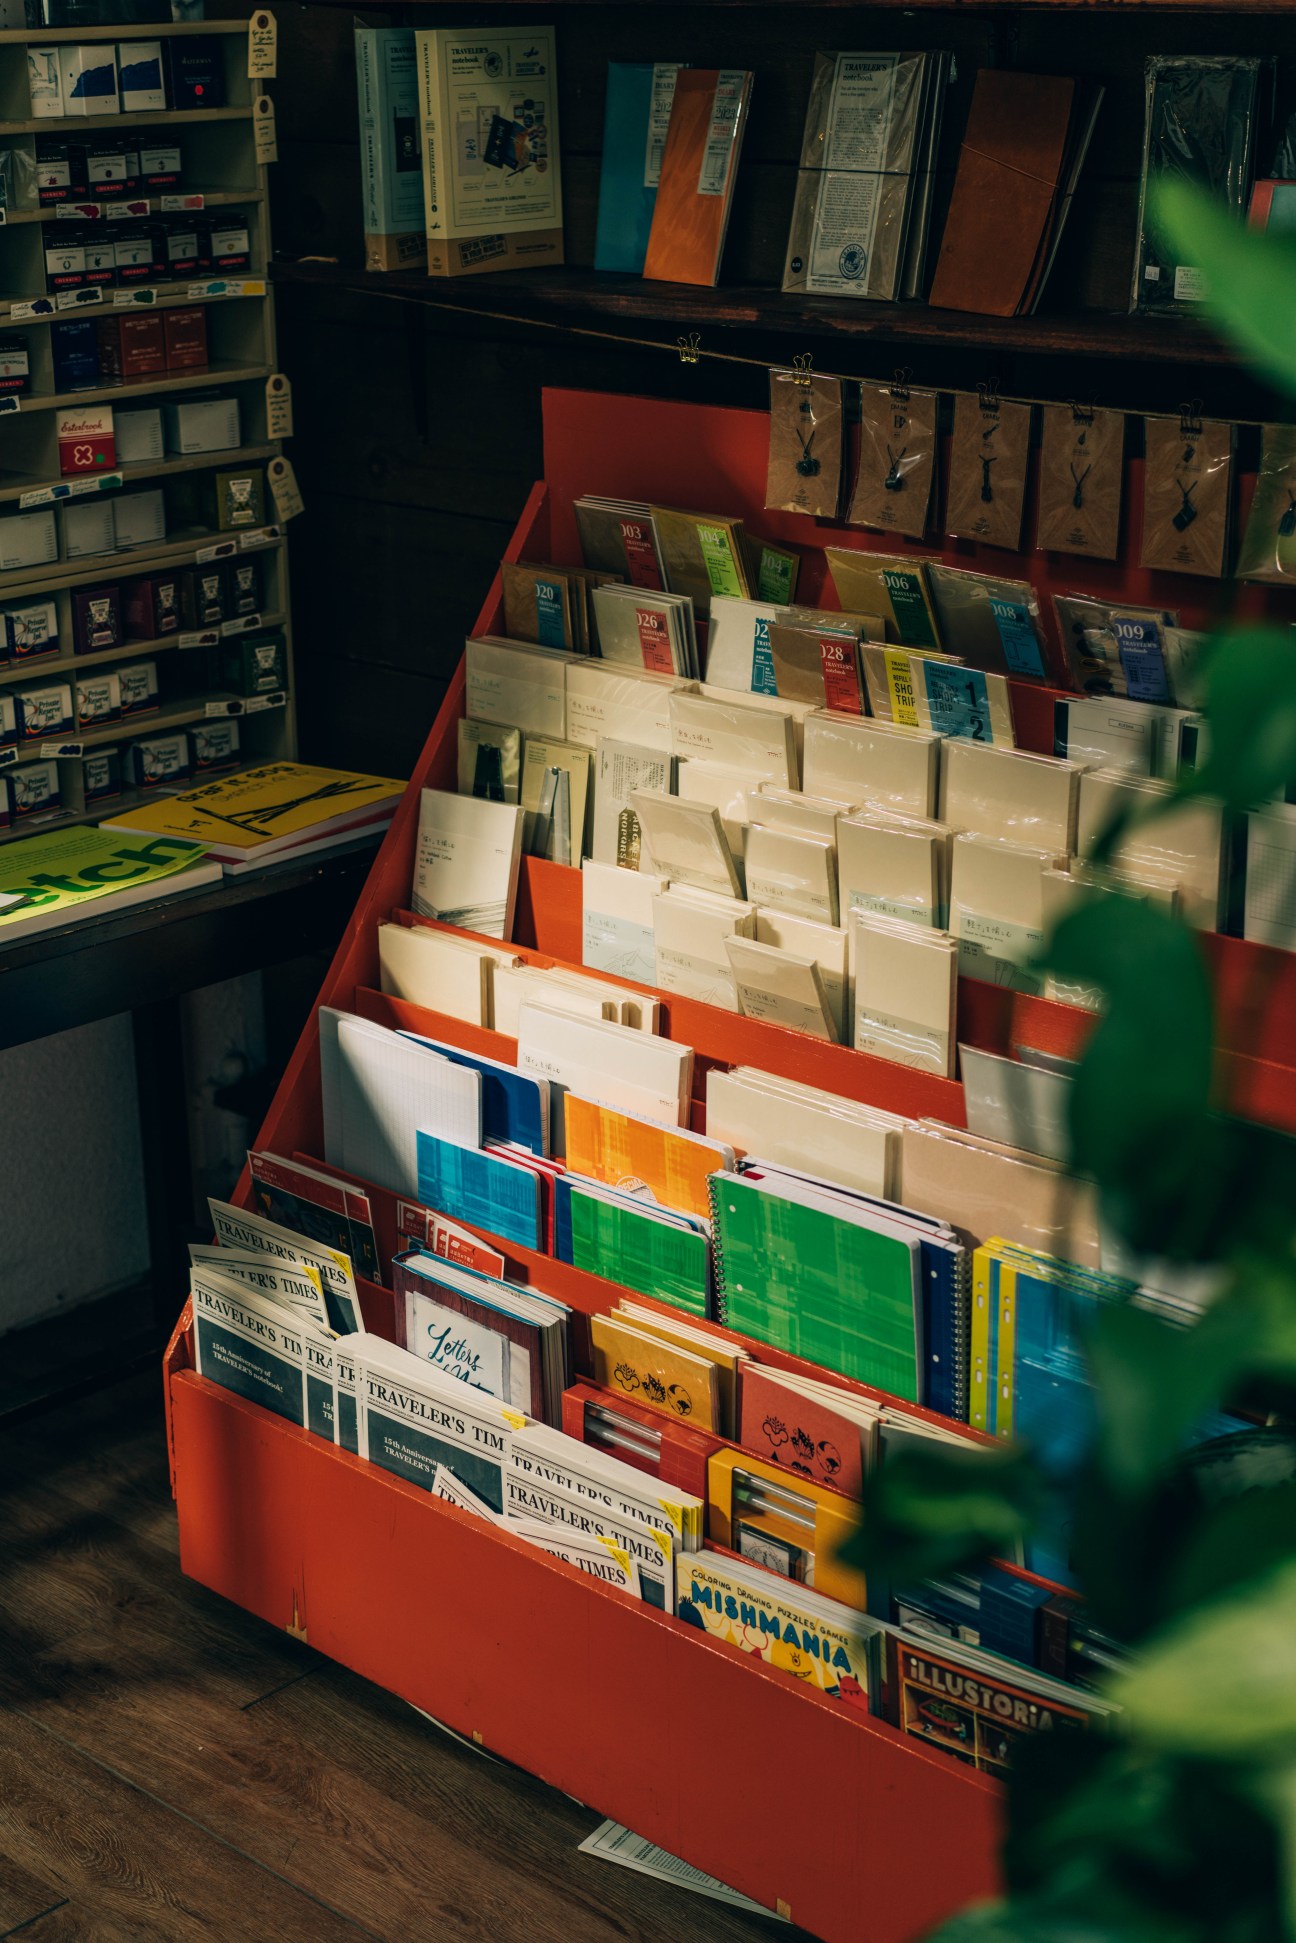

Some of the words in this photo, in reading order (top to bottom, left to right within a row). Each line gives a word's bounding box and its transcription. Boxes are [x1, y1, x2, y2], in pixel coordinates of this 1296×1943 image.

[452, 56, 479, 64] notebook
[844, 63, 887, 72] TRAVELER'S
[843, 73, 873, 81] notebook
[655, 102, 672, 113] 202
[715, 108, 736, 119] 2023
[61, 419, 103, 433] Esterbrook
[884, 574, 909, 590] 006
[754, 622, 769, 639] 02
[825, 661, 854, 671] TRAVELER'S
[87, 689, 108, 698] Private
[895, 683, 913, 695] SHO
[38, 699, 60, 708] Private
[87, 696, 110, 705] Reserve
[933, 701, 953, 711] TRIP
[38, 706, 61, 715] Reserve
[216, 1218, 296, 1263] TRAVELER'S
[300, 1255, 347, 1285] TIMES
[281, 1278, 319, 1301] TIMES
[195, 1289, 276, 1342] TRAVELER'S
[281, 1335, 302, 1356] TIM
[428, 1324, 484, 1371] Letters
[212, 1342, 226, 1354] 15th
[227, 1349, 264, 1374] Anniversary
[264, 1368, 272, 1377] of
[213, 1351, 253, 1376] TRAVELER'S
[253, 1372, 283, 1393] notebook!
[366, 1379, 465, 1435] TRAVELER'S
[472, 1426, 505, 1453] TIM
[384, 1436, 400, 1450] 15th
[384, 1446, 430, 1473] TRAVELER'S
[511, 1454, 612, 1507] TRAVELER'S
[620, 1502, 674, 1538] TIMES
[506, 1482, 604, 1537] TRAVELER'S
[611, 1530, 664, 1567] TIMES
[576, 1557, 627, 1585] TIMES
[691, 1569, 732, 1591] COLORING
[736, 1587, 772, 1610] DRAWING
[777, 1606, 816, 1631] PUZZLES
[819, 1626, 849, 1646] GAMES
[691, 1580, 852, 1673] MISHMANIA
